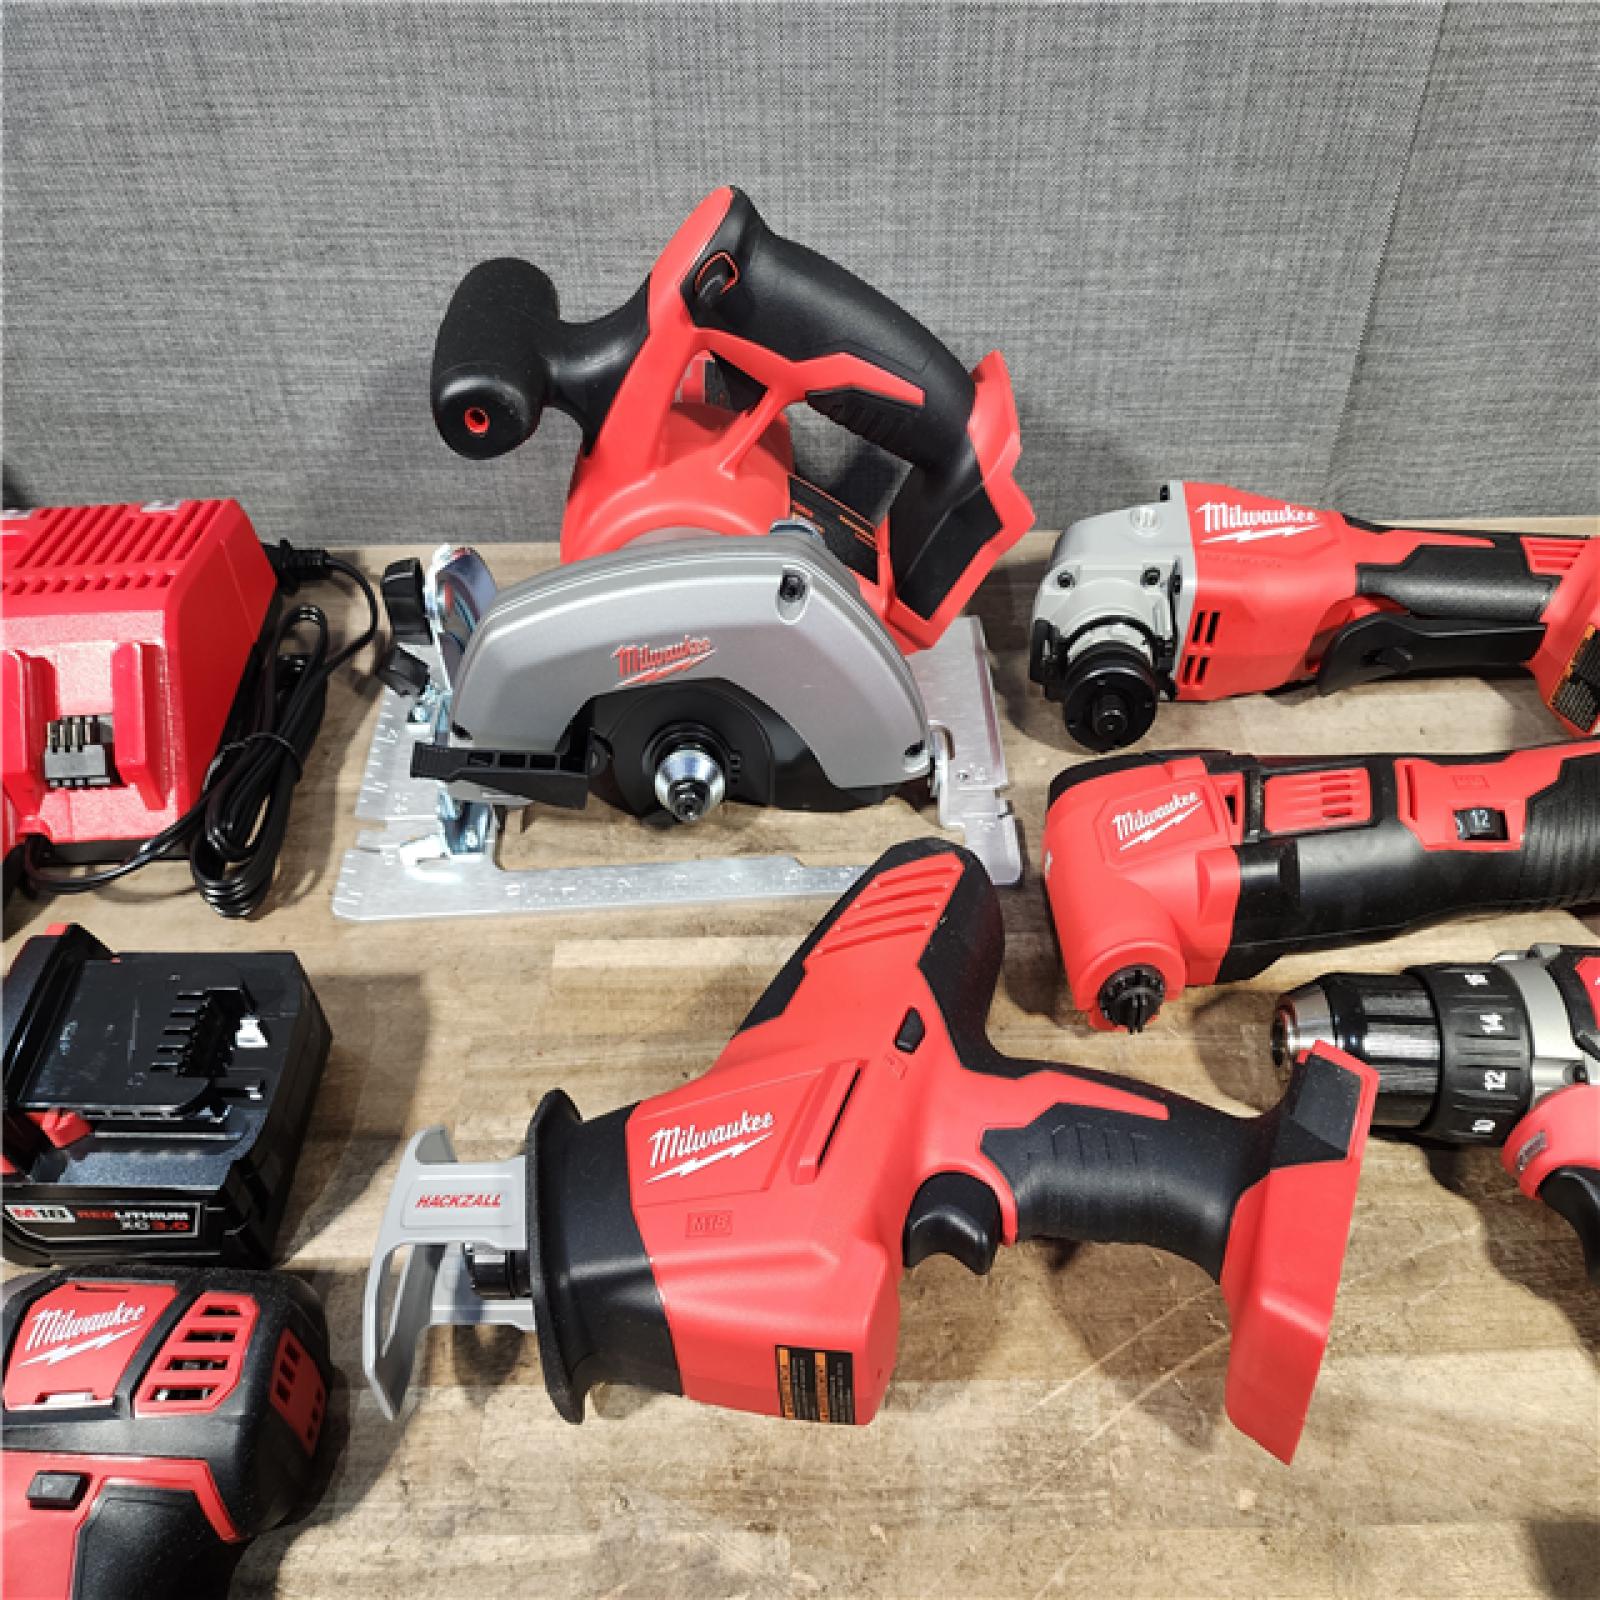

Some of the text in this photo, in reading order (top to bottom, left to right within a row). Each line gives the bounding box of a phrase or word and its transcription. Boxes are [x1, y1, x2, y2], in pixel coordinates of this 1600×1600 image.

[1194, 501, 1318, 533] Milwaukee
[609, 634, 712, 678] Milwaukee
[1111, 791, 1199, 841] Milwaukee
[1470, 809, 1491, 829] 12
[1479, 1013, 1506, 1033] 14
[1484, 1069, 1507, 1091] 12
[648, 1111, 775, 1168] Milwaukee
[414, 1193, 502, 1209] HACKZALL
[24, 1300, 146, 1352] Milwaukee
